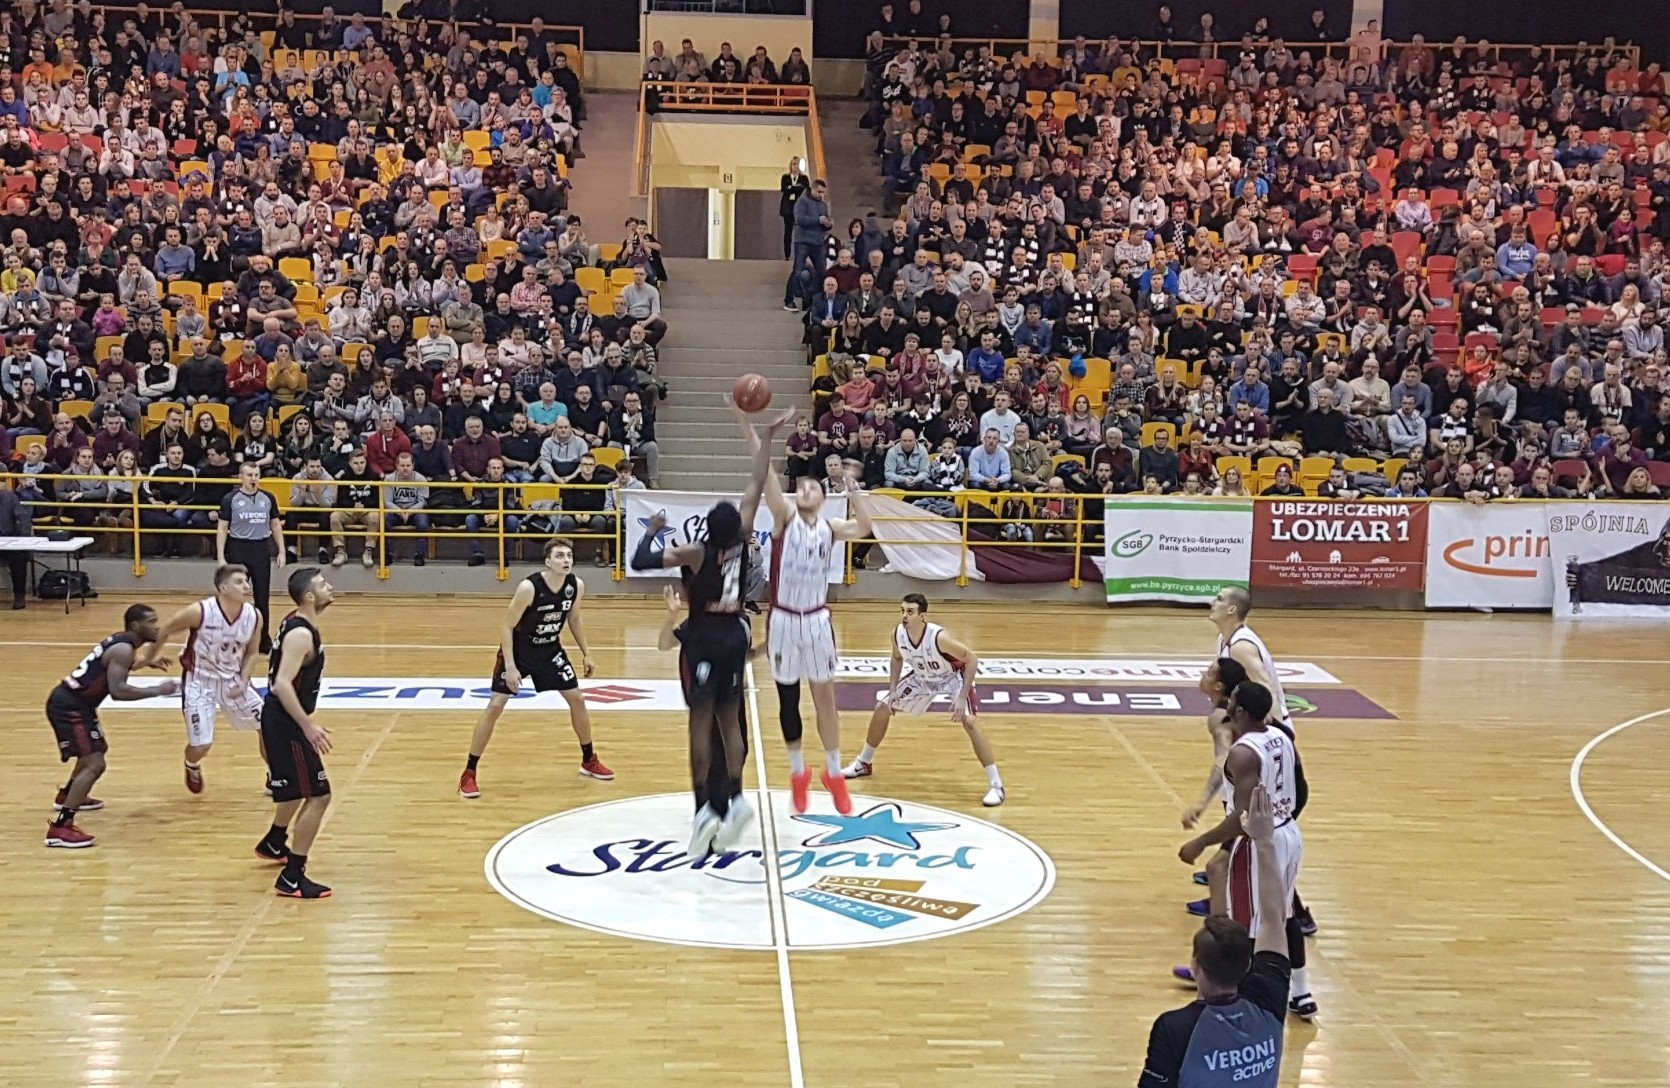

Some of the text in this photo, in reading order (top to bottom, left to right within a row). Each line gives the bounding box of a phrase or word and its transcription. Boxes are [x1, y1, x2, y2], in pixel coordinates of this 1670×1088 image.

[1270, 502, 1411, 517] UBEZPIECZENIA
[1550, 509, 1649, 535] SPÓJNIA
[1270, 518, 1410, 542] LOMAR 1
[1122, 540, 1143, 550] SGB
[1159, 543, 1180, 552] Bank
[1606, 575, 1670, 594] WELCOME
[561, 599, 573, 611] 13
[927, 661, 940, 670] 10
[824, 876, 881, 888] pod
[1203, 1035, 1277, 1072] VERONI
[1232, 1056, 1277, 1082] active
